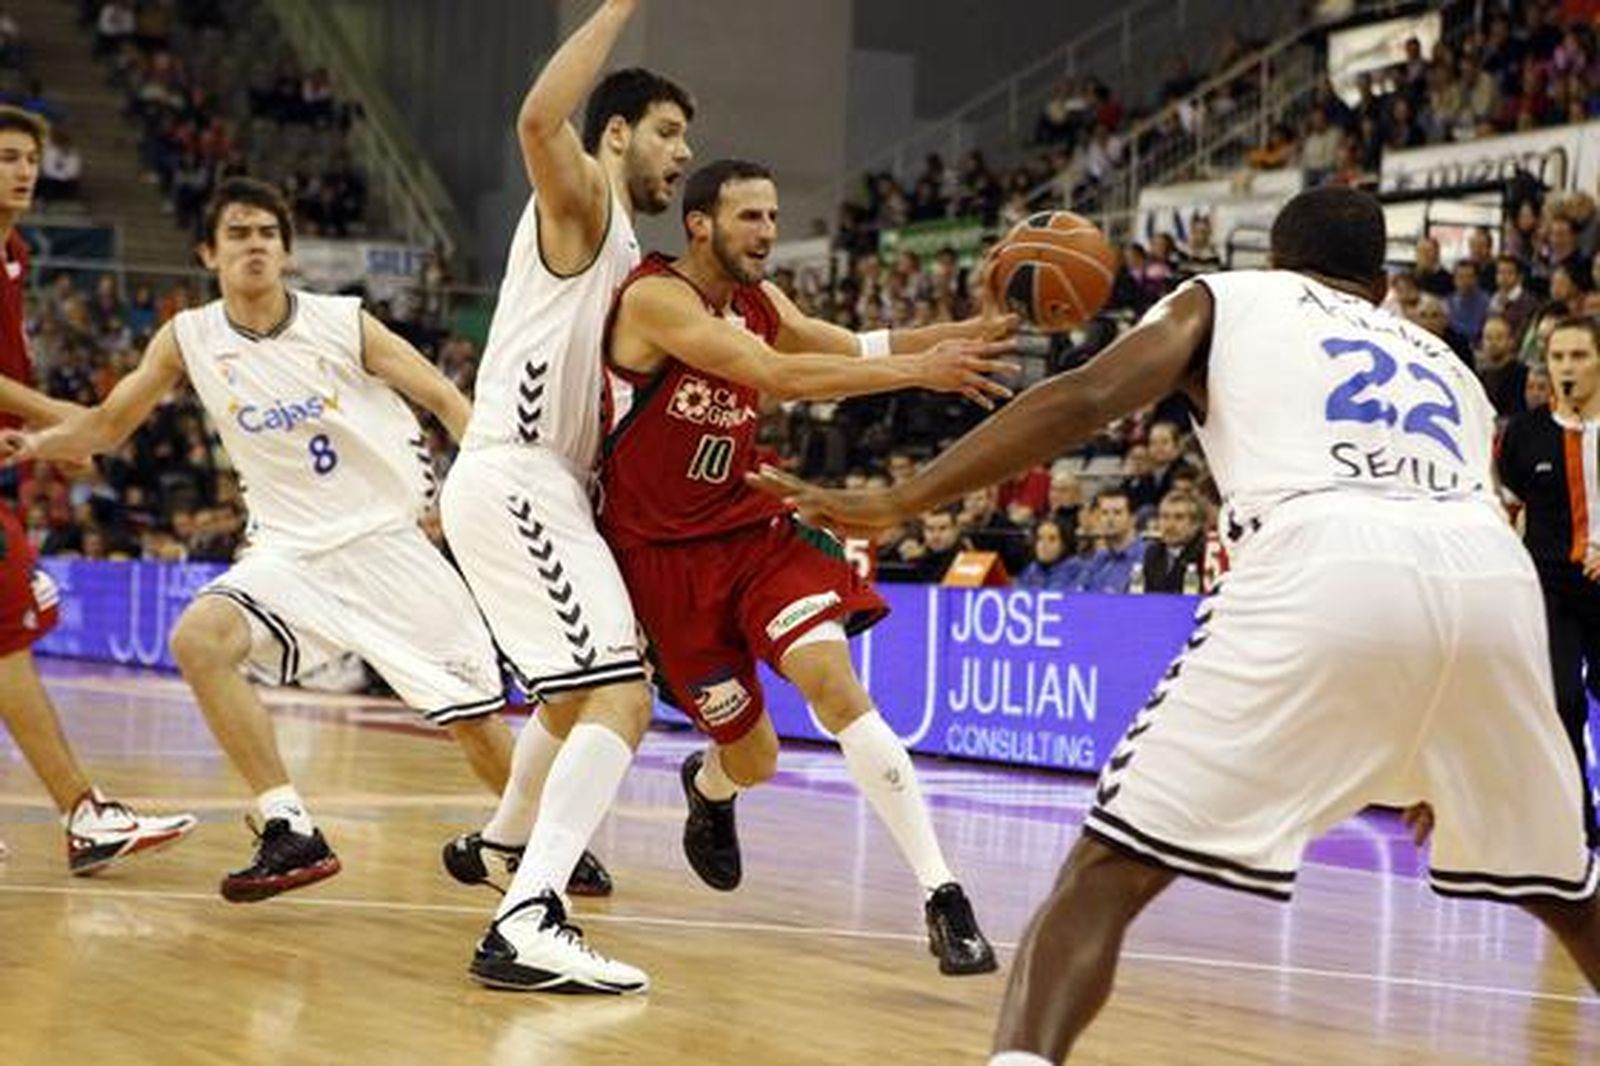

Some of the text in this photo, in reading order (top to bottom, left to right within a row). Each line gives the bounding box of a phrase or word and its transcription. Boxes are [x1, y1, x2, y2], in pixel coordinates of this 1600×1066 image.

[1321, 337, 1465, 464] 22
[309, 434, 337, 475] 8
[687, 434, 735, 484] 10
[845, 539, 869, 577] 5
[951, 590, 1064, 647] JOSE
[949, 656, 1098, 722] JULIAN
[946, 724, 1095, 768] CONSULTING
